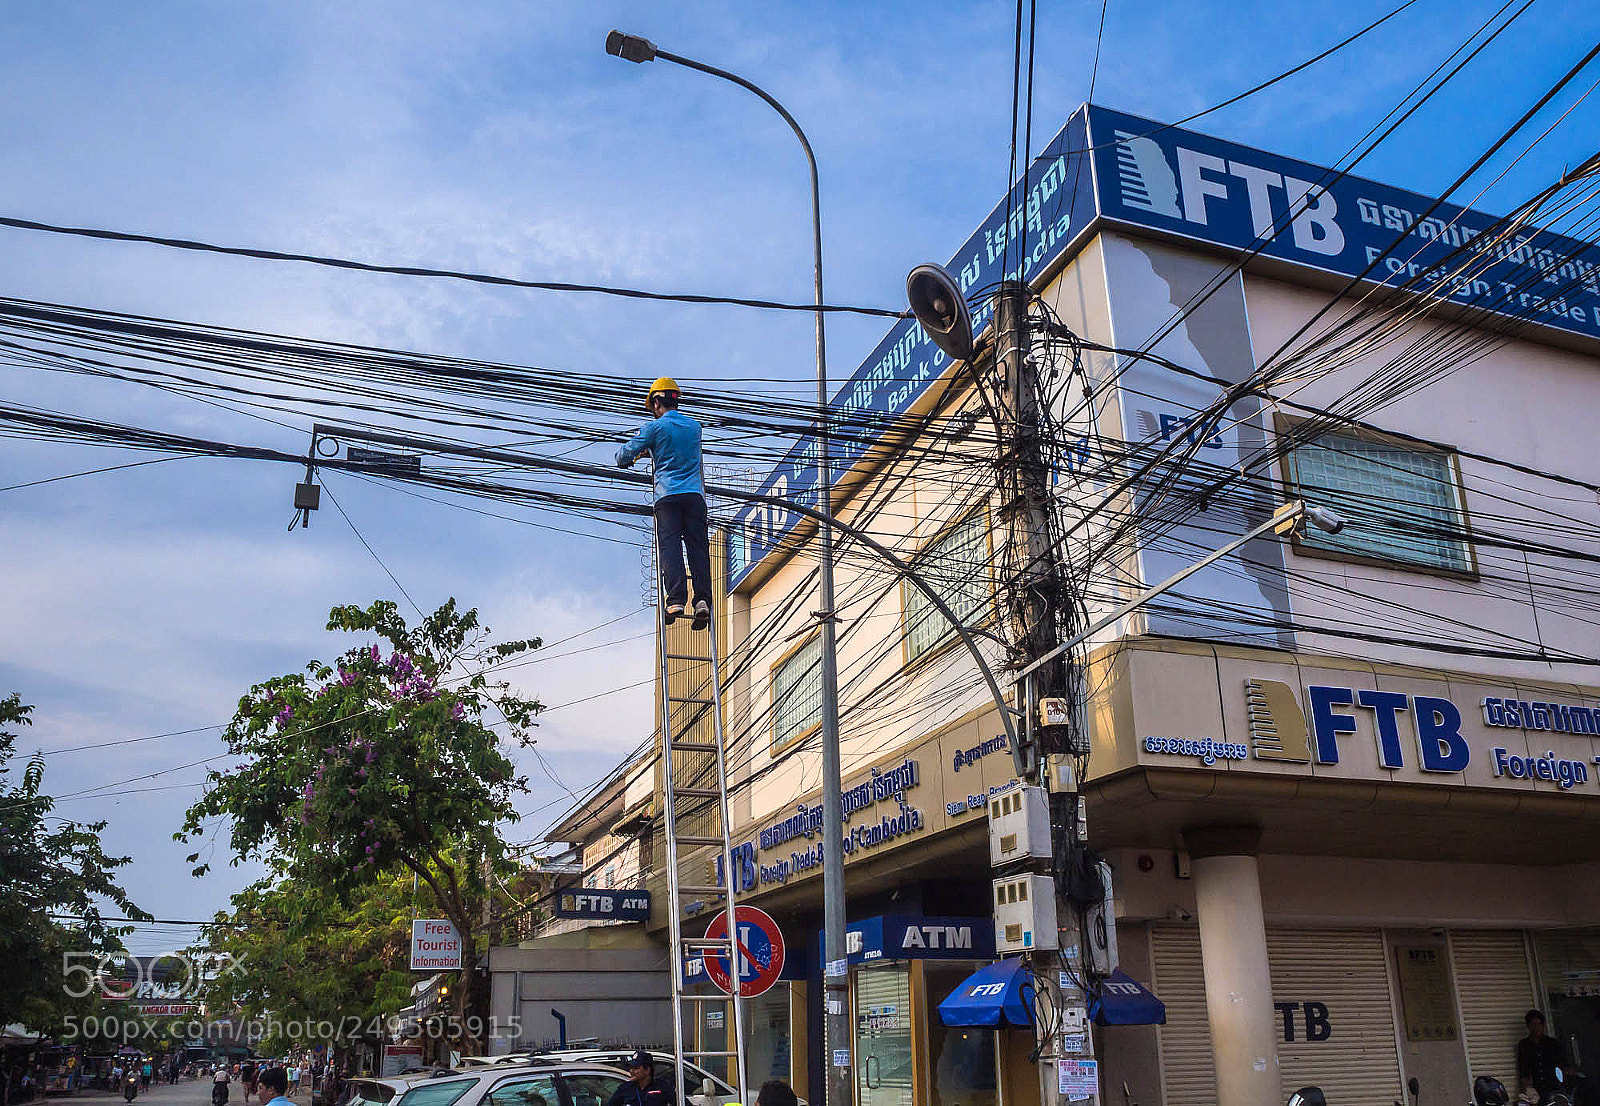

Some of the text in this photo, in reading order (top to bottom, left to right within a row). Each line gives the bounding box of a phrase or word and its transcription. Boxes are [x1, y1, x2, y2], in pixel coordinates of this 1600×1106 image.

[1176, 146, 1345, 257] FTB
[888, 361, 930, 414] Bank
[1308, 685, 1471, 773] FTB
[1491, 747, 1588, 790] Foreign
[967, 793, 986, 808] Reap
[760, 859, 790, 884] Foreign
[791, 845, 818, 872] Trade
[843, 827, 857, 854] of
[858, 802, 921, 849] Cambodia
[575, 894, 648, 912] FTB ATM
[425, 922, 450, 935] Free
[902, 926, 972, 949] ATM
[416, 938, 458, 950] Tourist
[413, 956, 460, 967] Information
[969, 982, 1006, 997] FTB
[1105, 982, 1142, 994] FTB
[170, 1005, 192, 1014] CENT
[1274, 1002, 1332, 1041] TB
